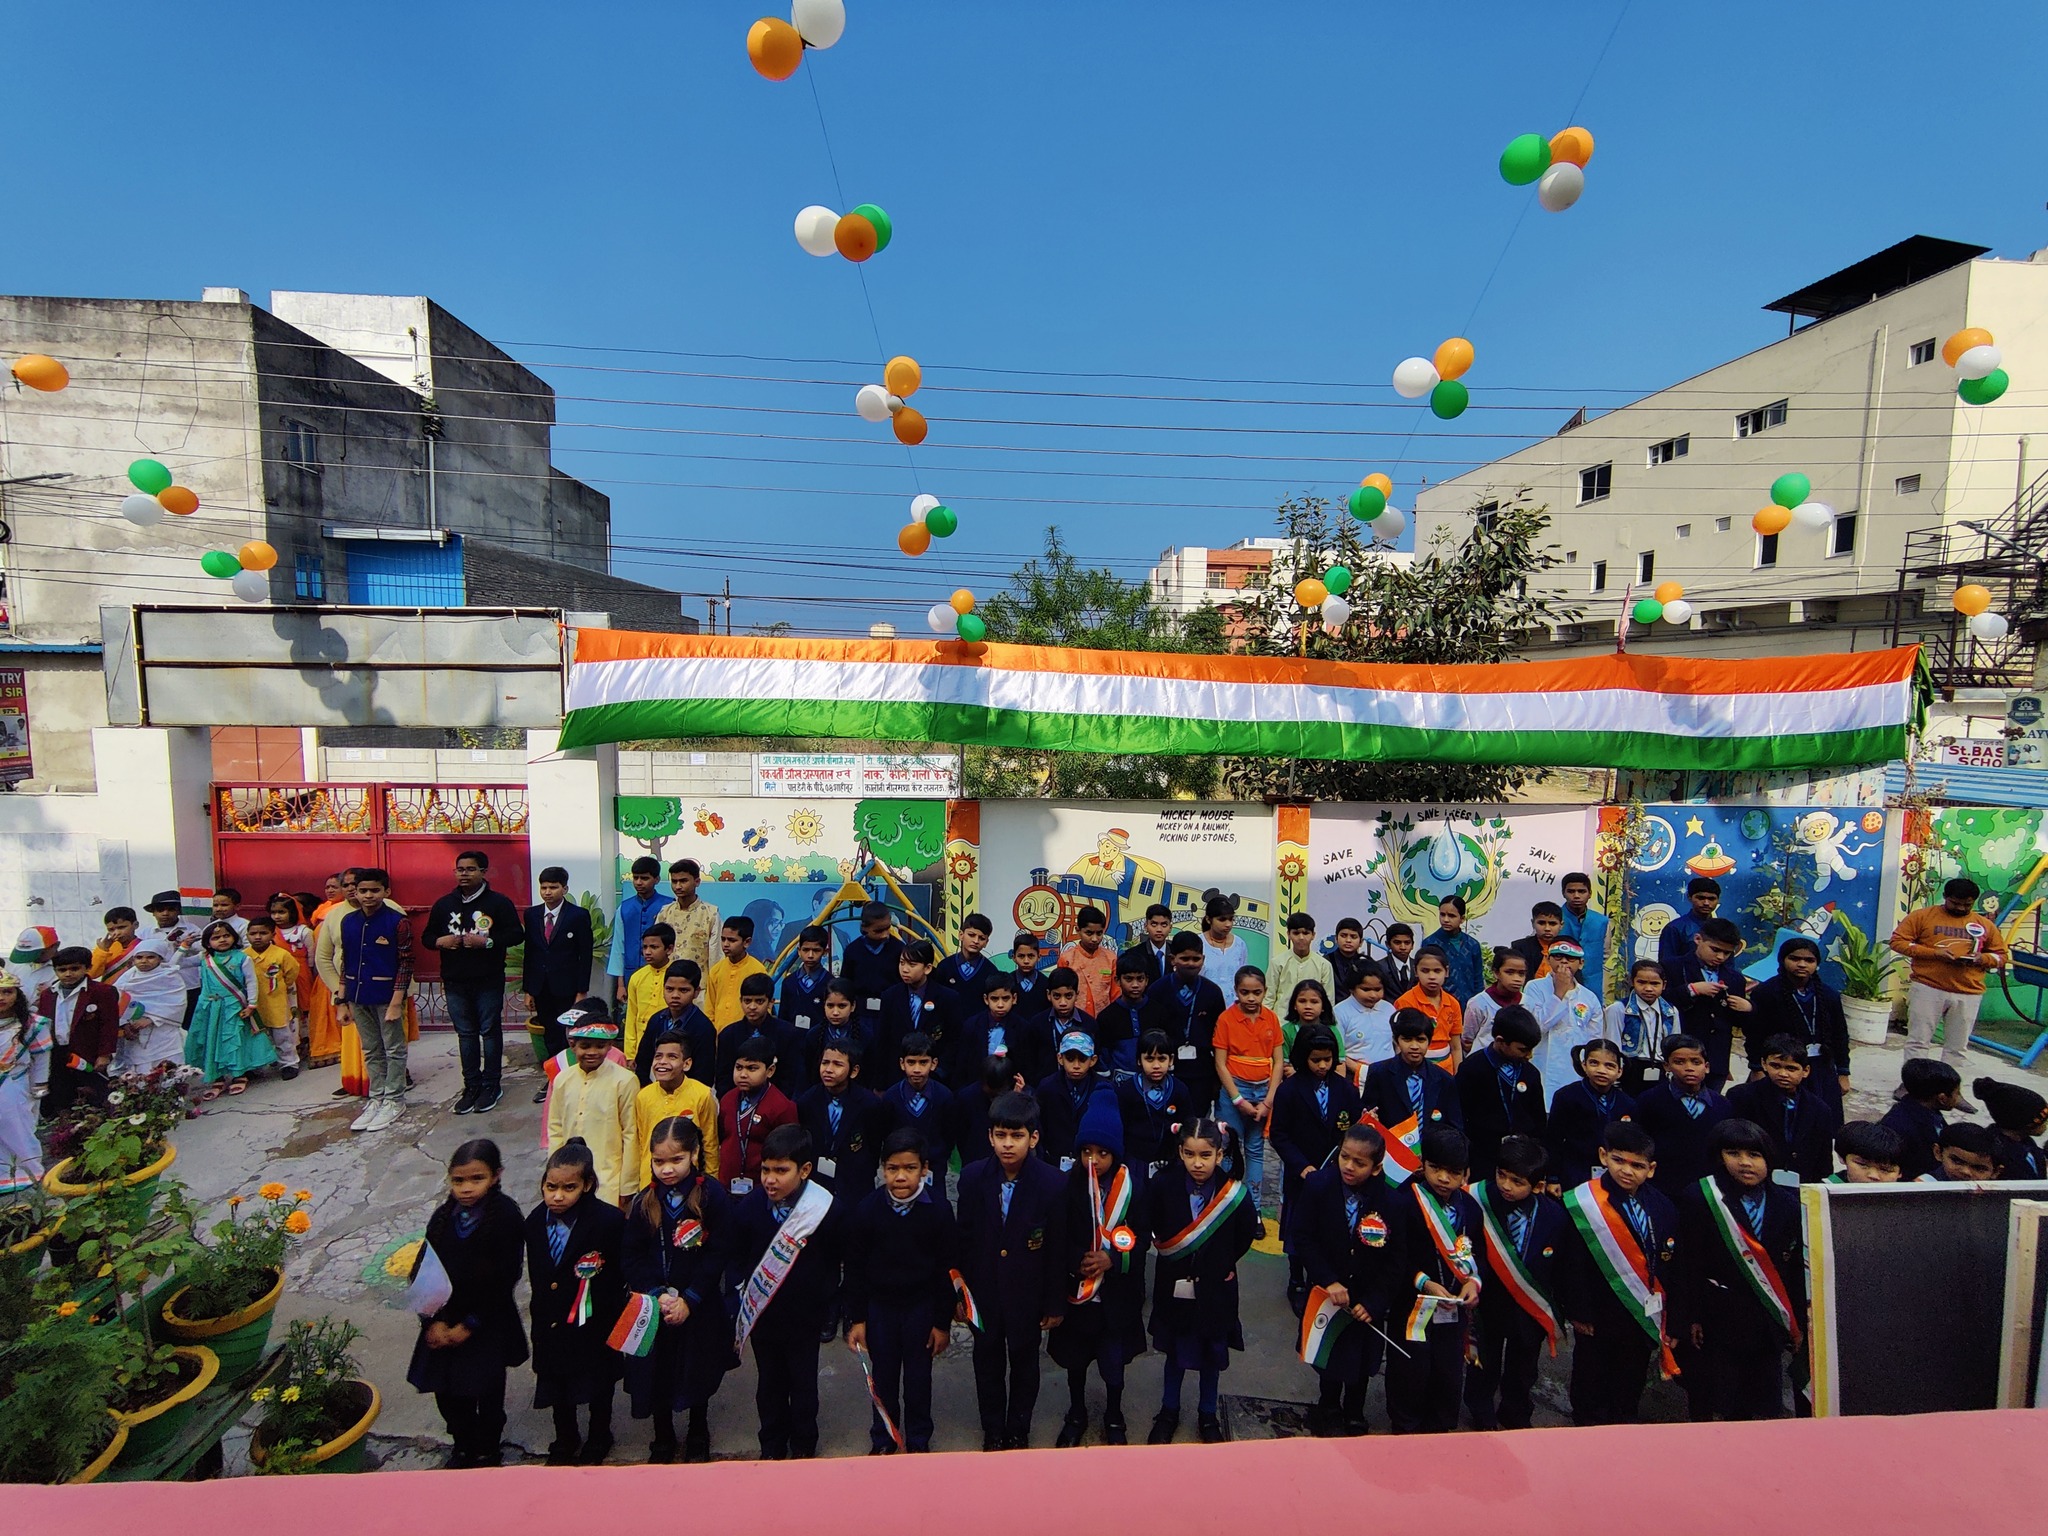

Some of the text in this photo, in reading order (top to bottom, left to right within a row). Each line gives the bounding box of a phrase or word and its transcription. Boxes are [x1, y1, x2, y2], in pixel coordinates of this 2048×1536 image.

[5, 687, 23, 697] SIR
[1160, 810, 1235, 820] MICKEY MOUSE
[1417, 807, 1439, 822] SAVE
[1202, 823, 1230, 832] RAILWAY,
[1159, 833, 1188, 842] PICKING
[1202, 834, 1237, 844] STONES,
[1323, 849, 1353, 865] SAVE
[1529, 846, 1557, 863] SAVE
[1324, 864, 1367, 884] WATER
[1517, 863, 1556, 885] EARTH
